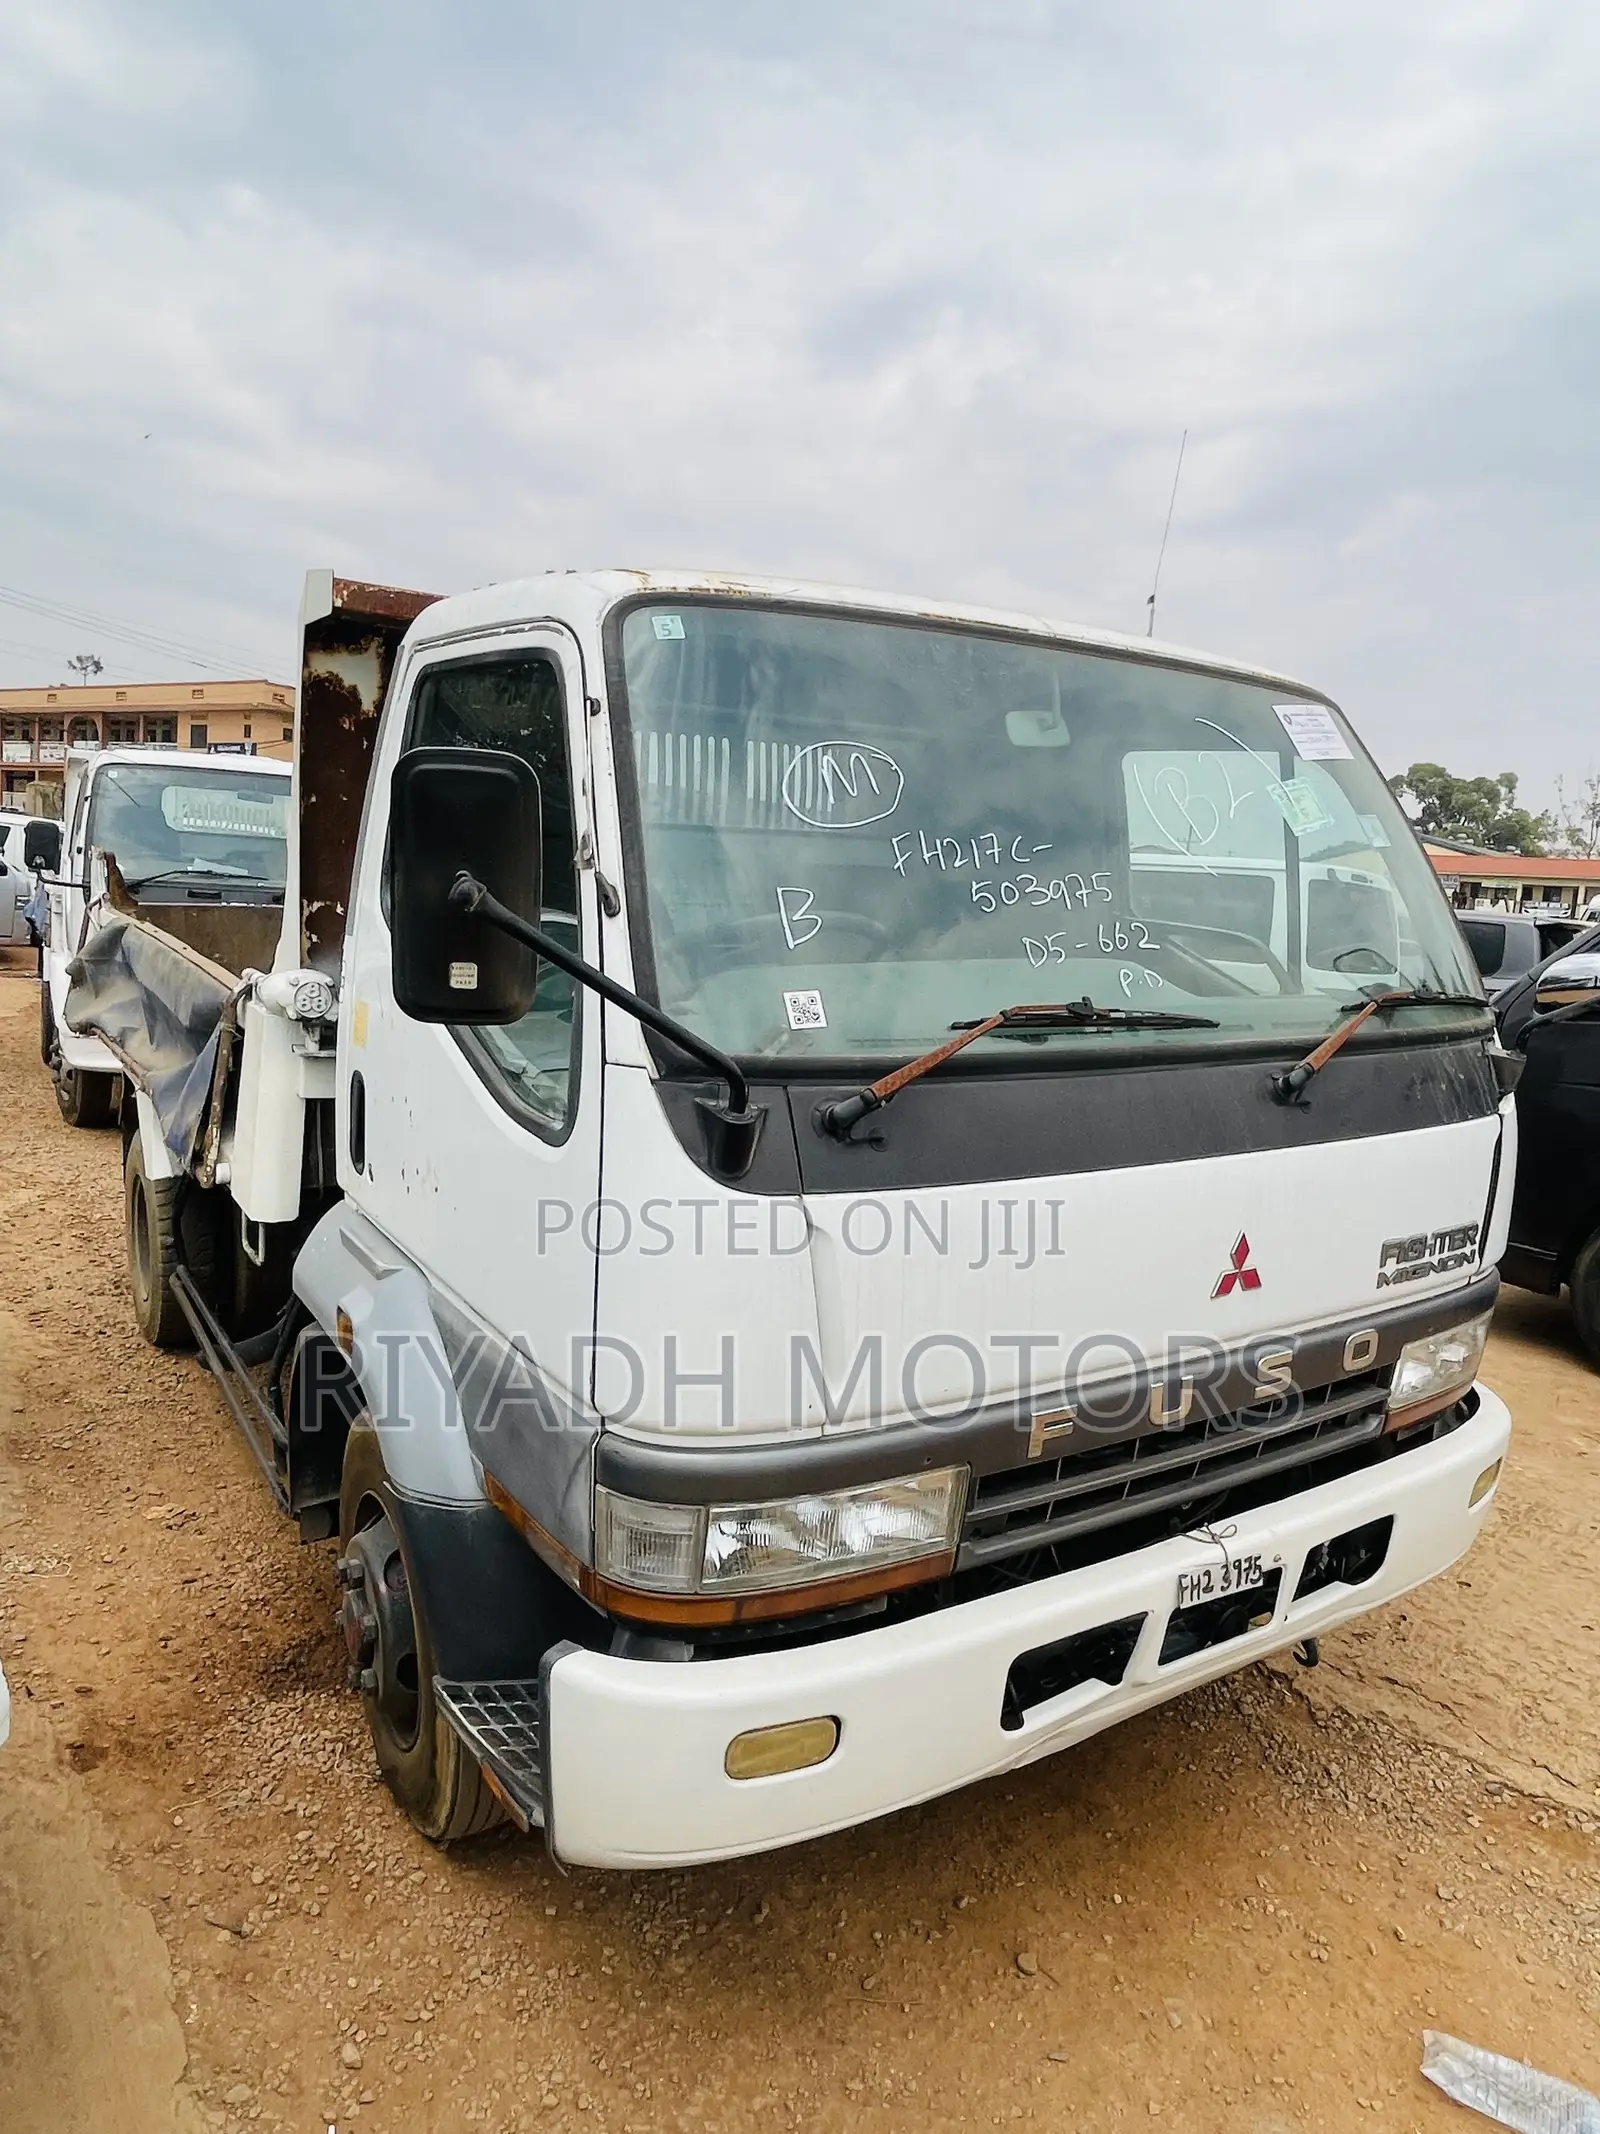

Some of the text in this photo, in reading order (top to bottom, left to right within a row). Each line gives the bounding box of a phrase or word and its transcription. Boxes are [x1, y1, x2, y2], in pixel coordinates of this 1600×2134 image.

[821, 751, 881, 805] M
[970, 871, 1114, 913] 503975
[776, 886, 824, 950] B
[1376, 1248, 1477, 1289] MIGNON
[1379, 1220, 1480, 1269] FIGHTER
[1027, 1329, 1380, 1459] FUSO
